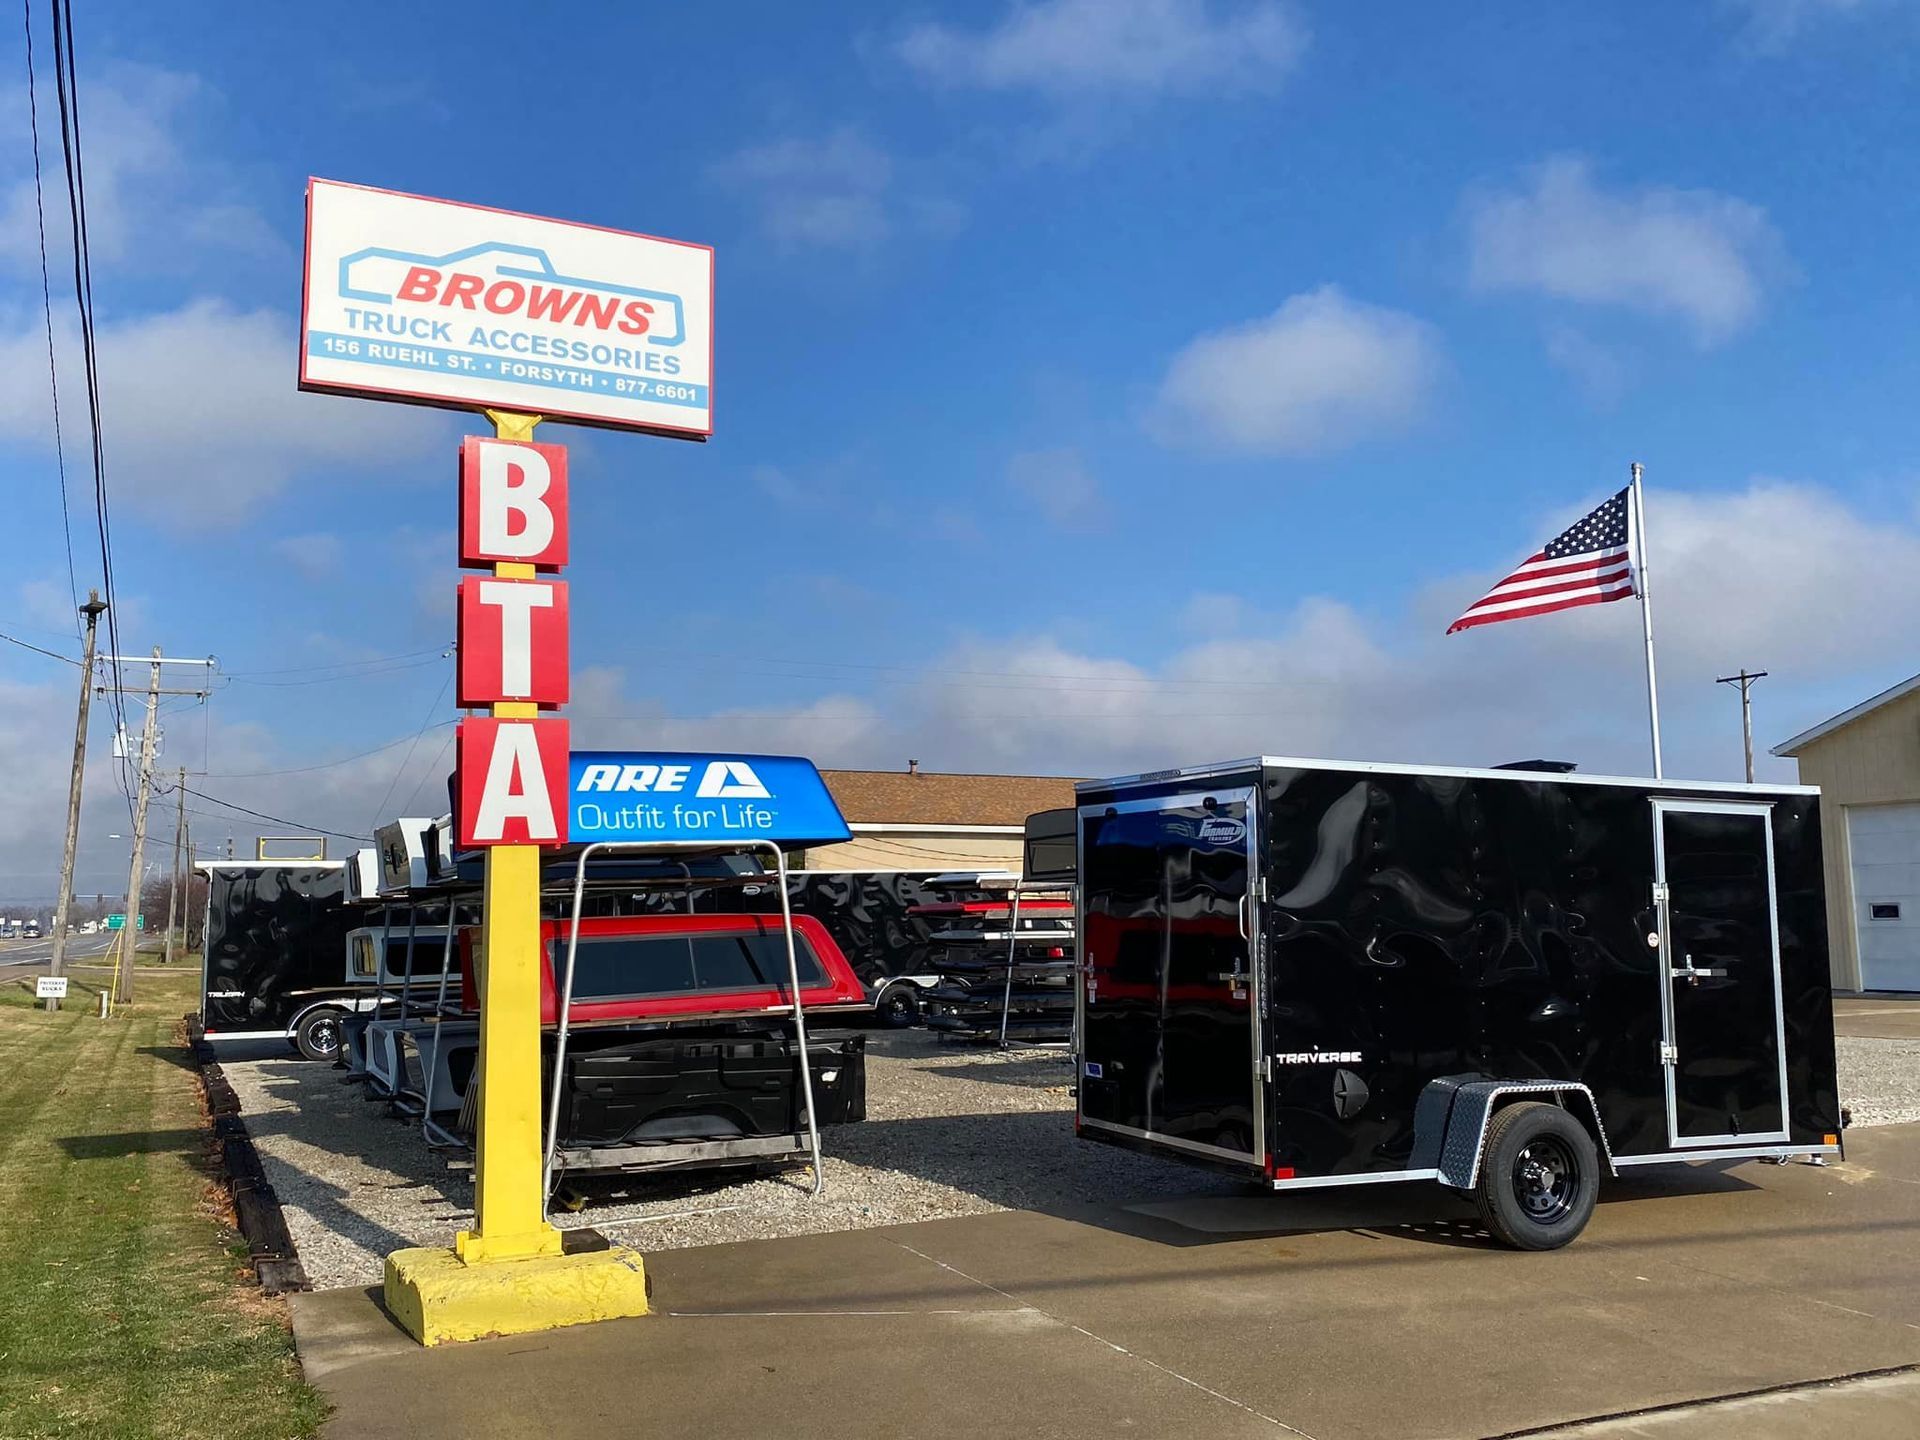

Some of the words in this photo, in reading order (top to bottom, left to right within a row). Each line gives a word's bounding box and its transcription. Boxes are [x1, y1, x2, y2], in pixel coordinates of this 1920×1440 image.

[396, 266, 655, 335] BROWNS
[343, 307, 453, 342] TRUCK
[468, 327, 681, 375] ACCESSORIES
[323, 337, 361, 355] 156
[367, 343, 440, 366] RUEHL
[446, 354, 477, 371] ST.
[500, 361, 594, 387] FORSYTH
[615, 378, 697, 402] 877-6601
[576, 764, 692, 792] ARE
[577, 803, 665, 830] Outfit
[673, 803, 717, 829] for
[1276, 1051, 1362, 1064] TRAVERSE
